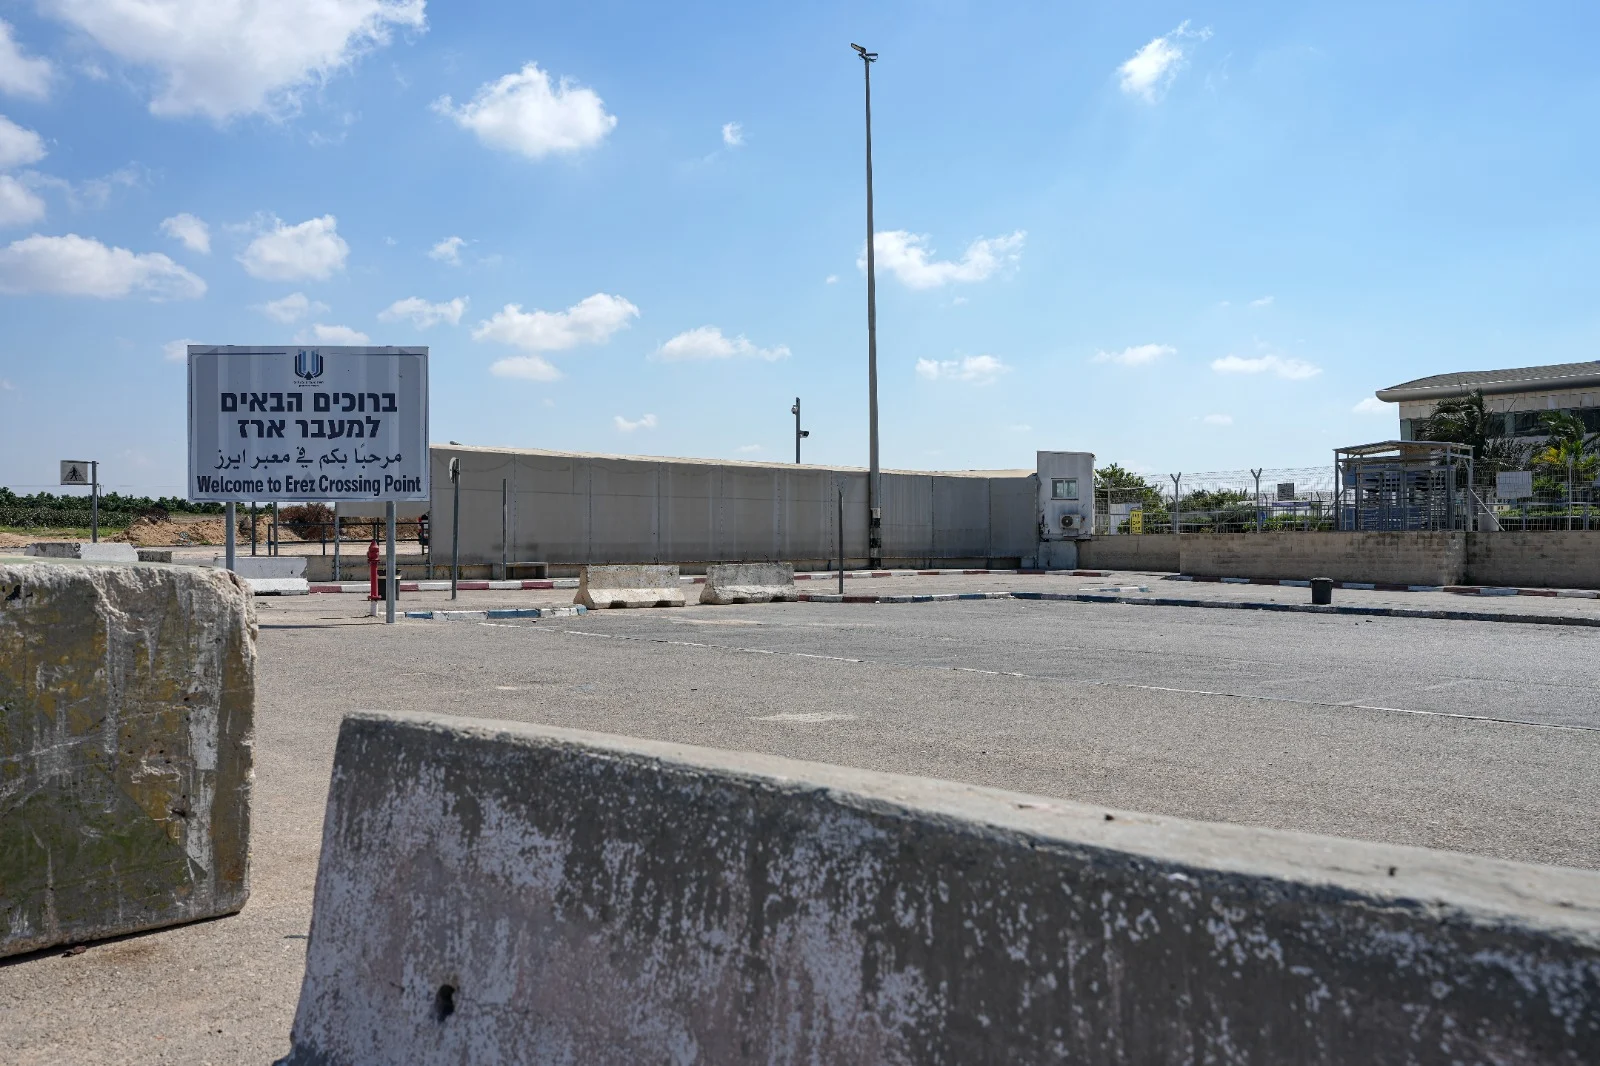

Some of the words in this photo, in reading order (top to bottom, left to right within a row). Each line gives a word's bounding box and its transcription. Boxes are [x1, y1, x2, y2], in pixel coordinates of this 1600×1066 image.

[221, 393, 303, 412] הבאים
[314, 393, 397, 412] ברוכים
[237, 419, 285, 439] ארז
[296, 416, 381, 439] למעבר
[250, 453, 290, 469] معبر
[296, 446, 313, 468] في
[319, 448, 347, 471] بكم
[197, 476, 264, 493] Welcome
[267, 477, 281, 493] to
[285, 475, 316, 493] Erez
[318, 475, 381, 497] Crossing
[384, 475, 421, 493] Point
